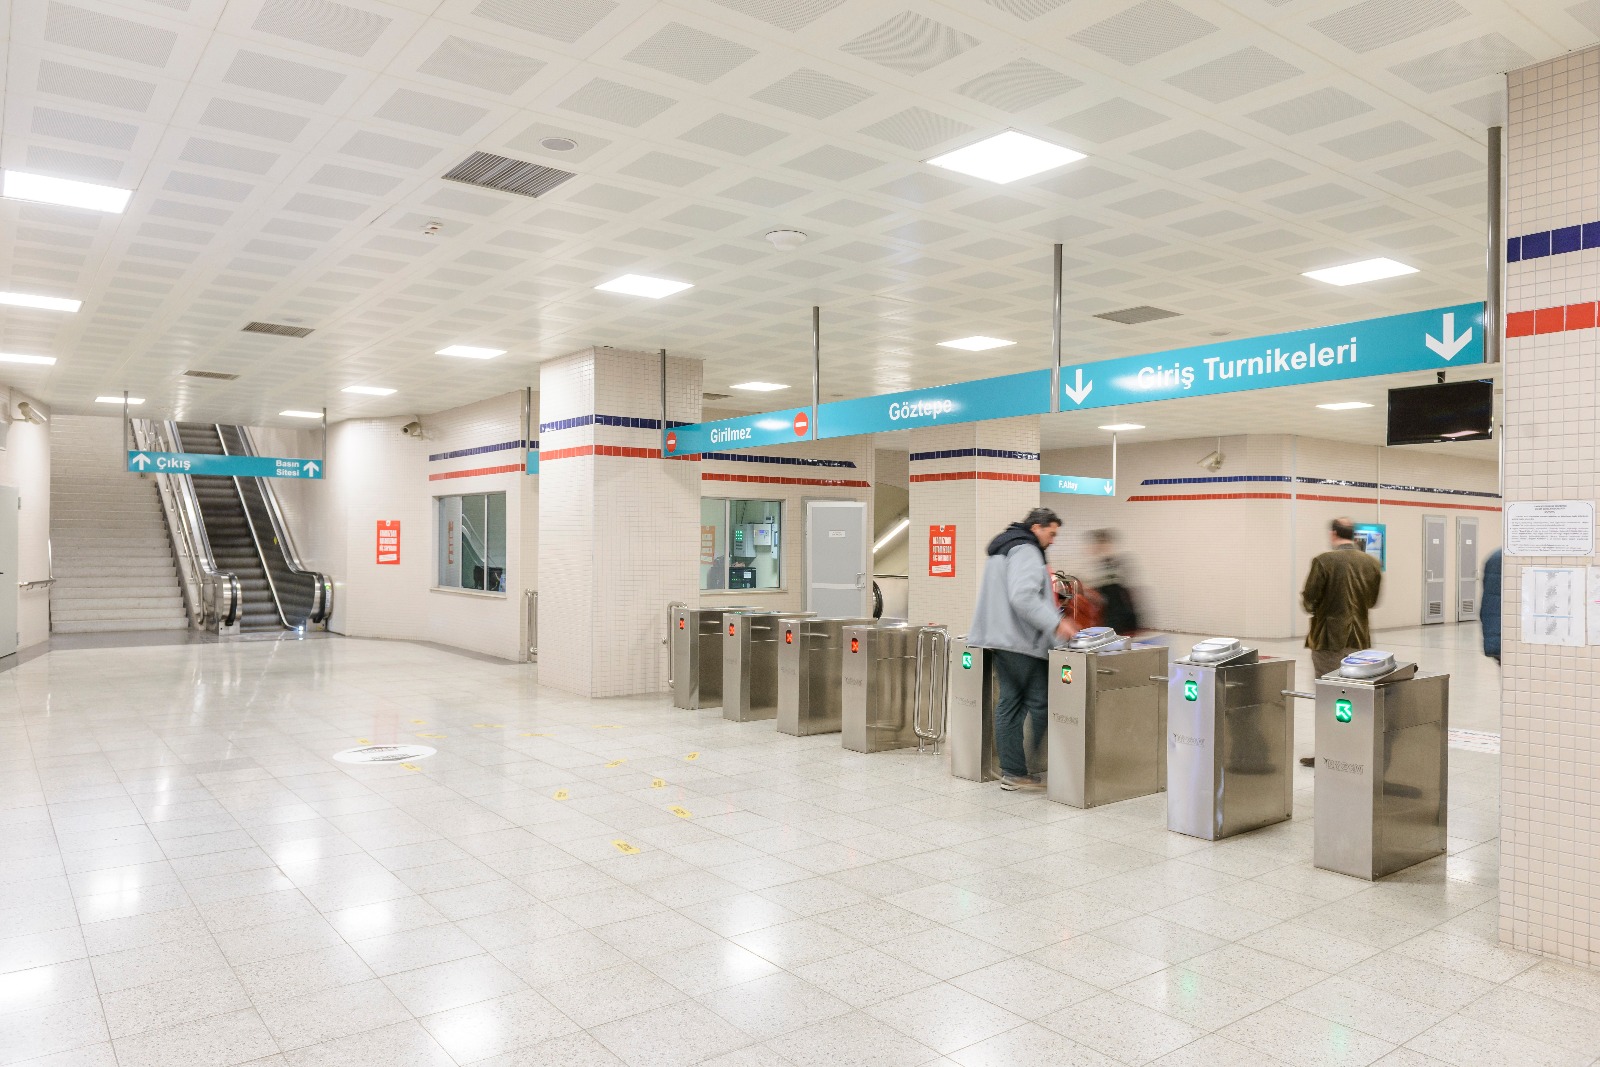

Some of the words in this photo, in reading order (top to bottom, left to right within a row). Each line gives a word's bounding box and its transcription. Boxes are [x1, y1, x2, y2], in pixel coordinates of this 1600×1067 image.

[1137, 362, 1195, 390] Giriş
[1203, 336, 1357, 381] Turnikeleri
[888, 399, 954, 421] Göztepe
[710, 427, 752, 444] Girilmez
[156, 457, 191, 471] Çıkış
[275, 459, 300, 468] Basın
[276, 468, 300, 477] Sitesi
